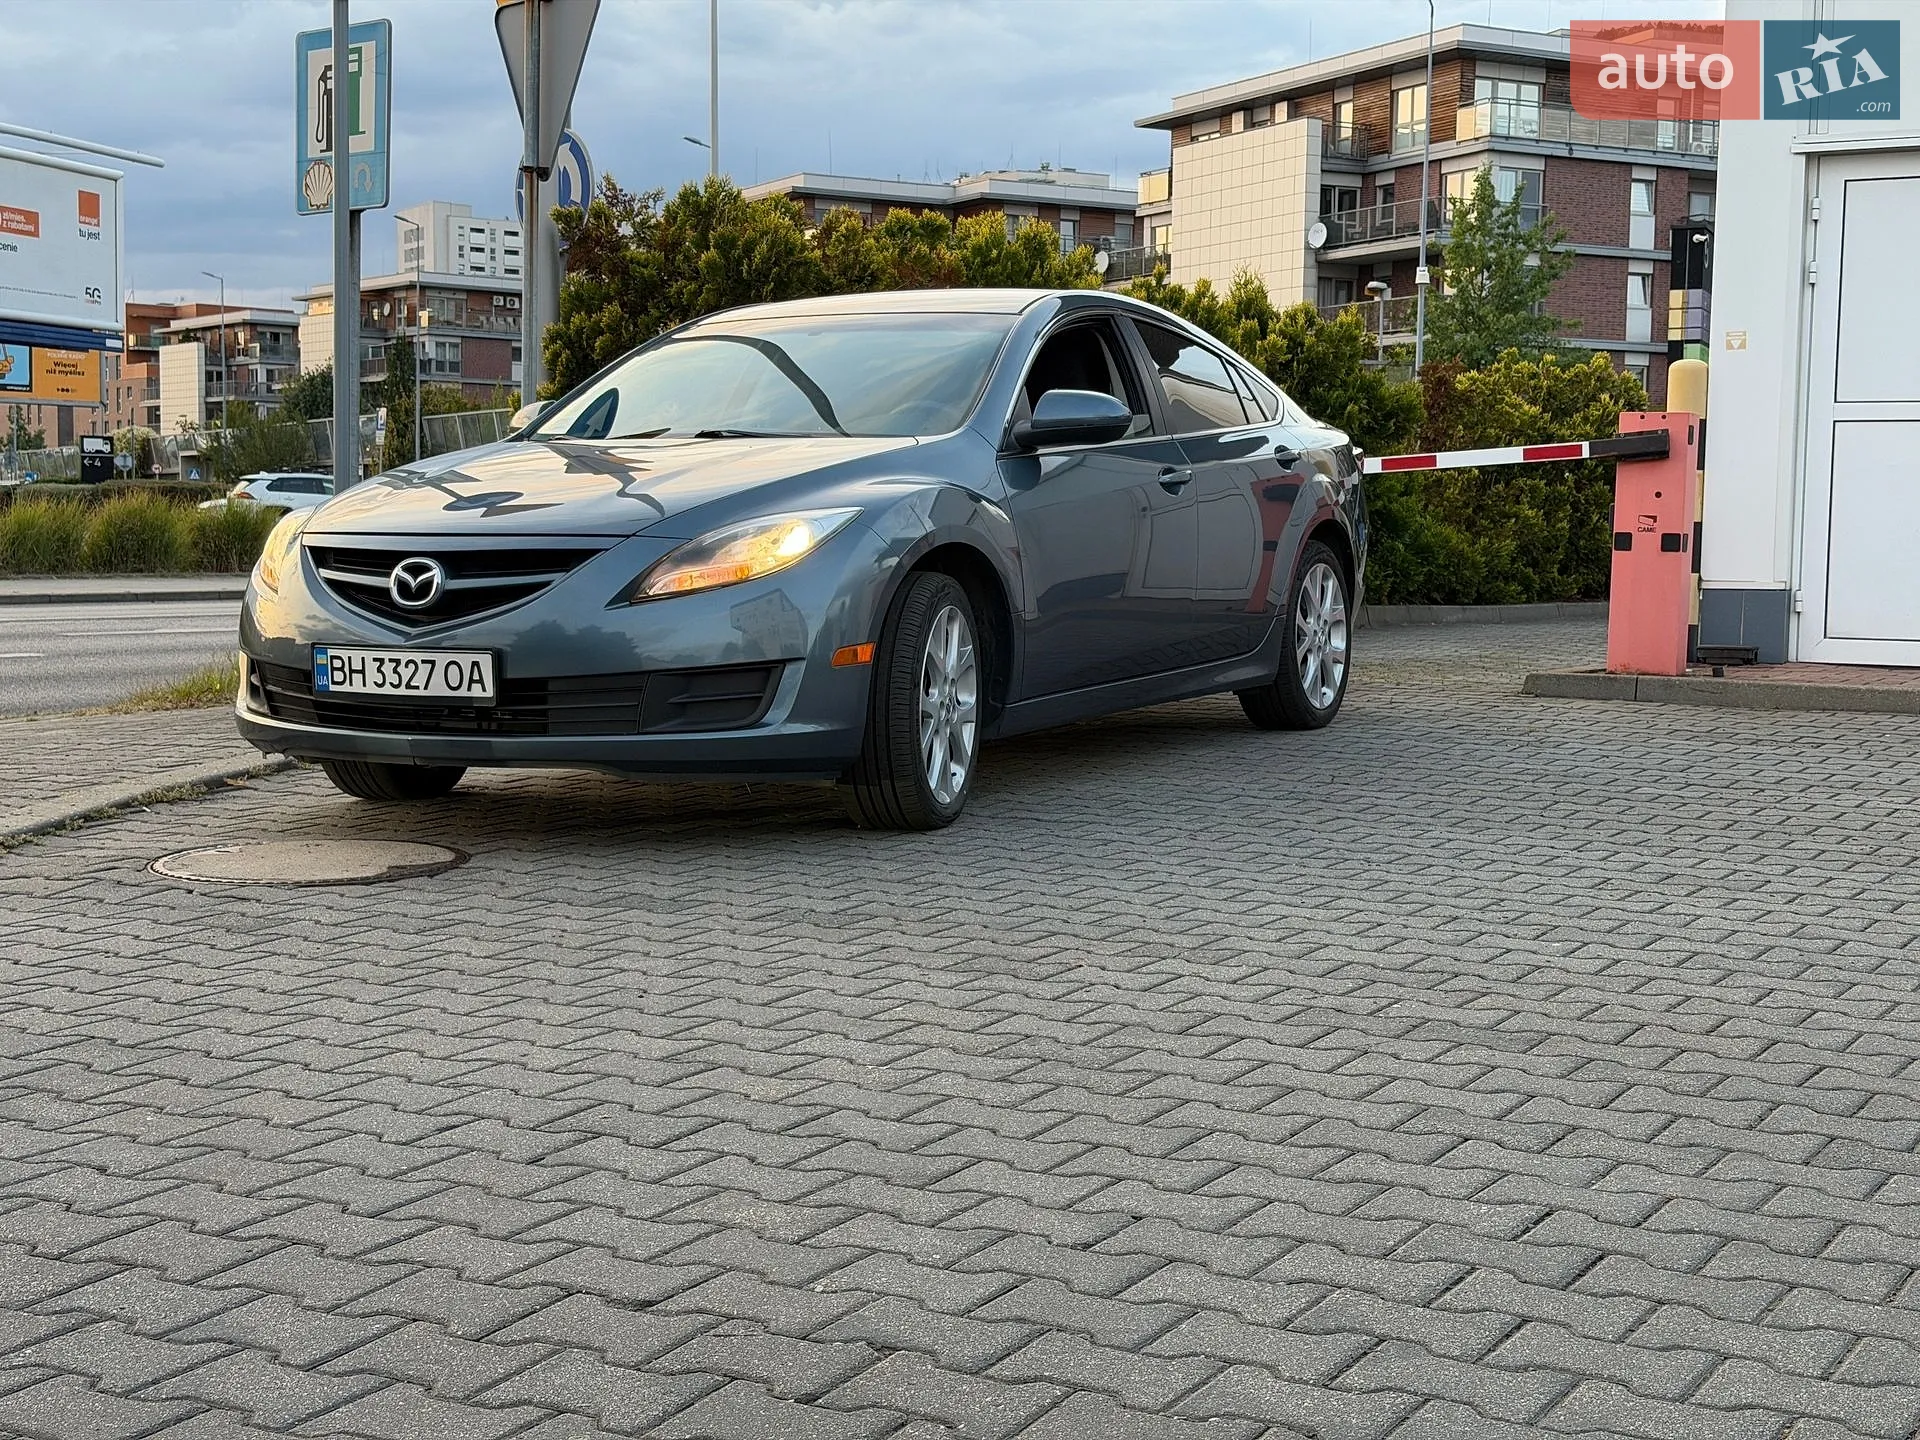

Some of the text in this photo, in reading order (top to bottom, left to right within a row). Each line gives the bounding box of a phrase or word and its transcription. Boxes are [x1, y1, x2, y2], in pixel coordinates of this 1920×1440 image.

[79, 228, 101, 240] tu jest
[85, 287, 101, 299] 5G
[53, 361, 78, 370] Więcej
[94, 457, 102, 467] 4
[329, 655, 487, 693] BH 3327 OA
[317, 676, 328, 686] UA
